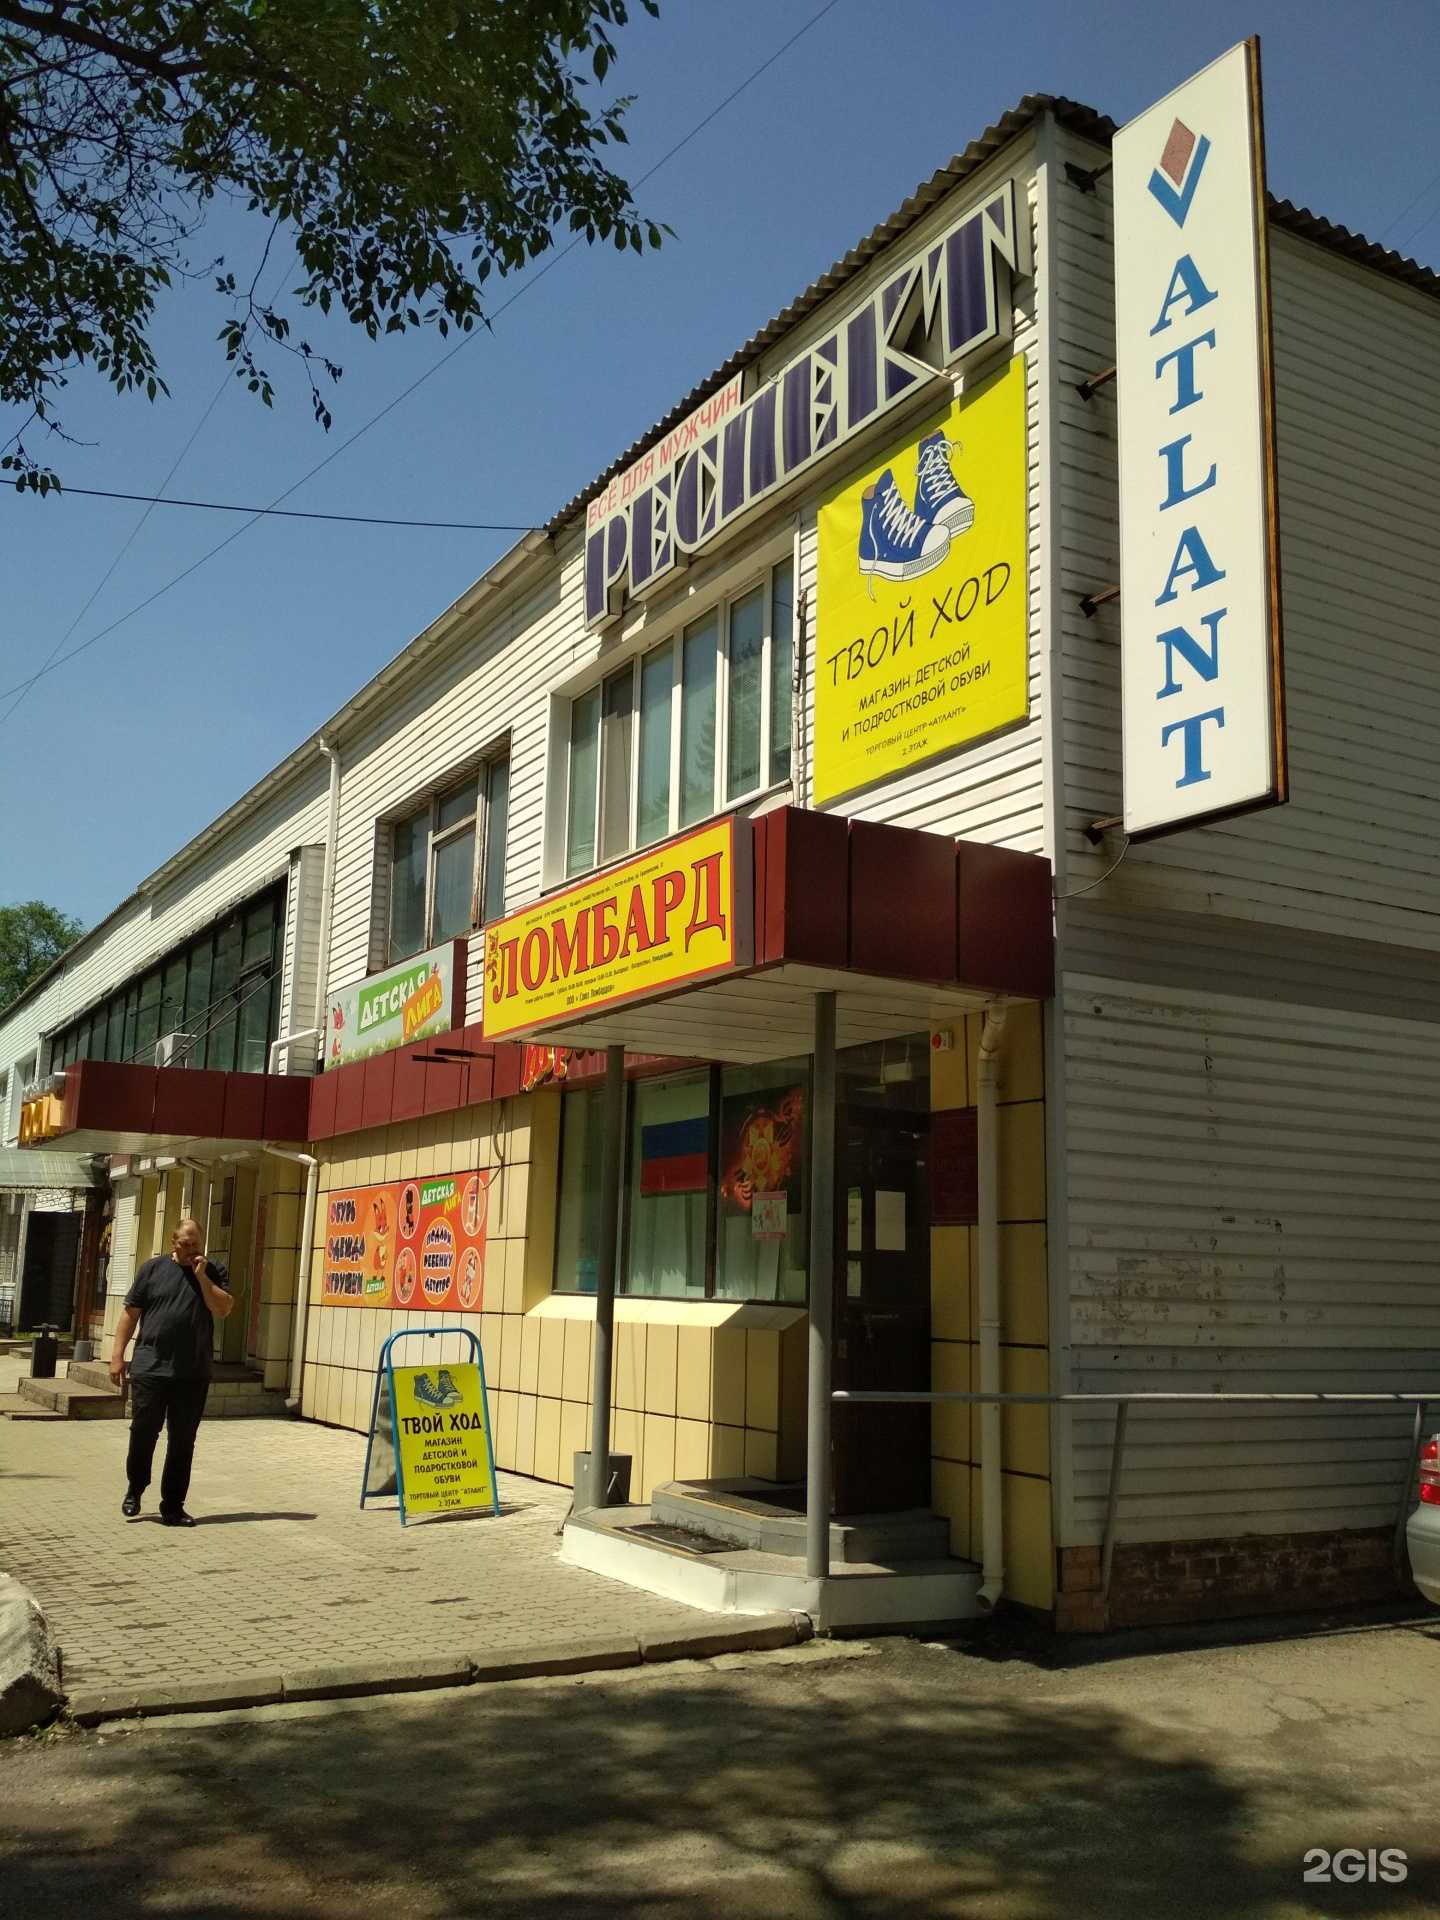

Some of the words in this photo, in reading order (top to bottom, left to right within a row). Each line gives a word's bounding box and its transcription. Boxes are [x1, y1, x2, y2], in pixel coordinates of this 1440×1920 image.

[588, 482, 617, 529] ВСЁ
[621, 453, 654, 505] ДЛЯ
[659, 381, 739, 468] МУЖЧИН
[1149, 252, 1228, 790] ATLANT
[826, 596, 915, 686] ТВОЙ
[859, 673, 911, 712] МАГАЗИН
[914, 642, 970, 687] ДЕТСКОЙ
[842, 727, 850, 742] И
[854, 679, 946, 735] ПОДРОСТКОВОЙ
[950, 660, 991, 692] ОБУВИ
[865, 731, 902, 756] ТОРГОВЫЙ
[903, 723, 927, 740] ЦЕНТР
[907, 739, 928, 753] ЭТАЖ
[493, 851, 726, 1004] ЛОМБАРД
[360, 970, 426, 1030] ДЕТСКАЯ
[404, 984, 442, 1034] ЛИГА
[401, 1412, 444, 1435] ТВОЙ
[449, 1412, 482, 1431] ХОД
[425, 1437, 463, 1447] МАГАЗИН
[414, 1459, 478, 1473] ПОДРОСТКОВОЙ
[422, 1449, 459, 1460] ДЕТСКОЙ
[461, 1449, 467, 1457] И
[409, 1490, 439, 1501] ТОРГОВЫЙ
[434, 1475, 461, 1485] ОБУВИ
